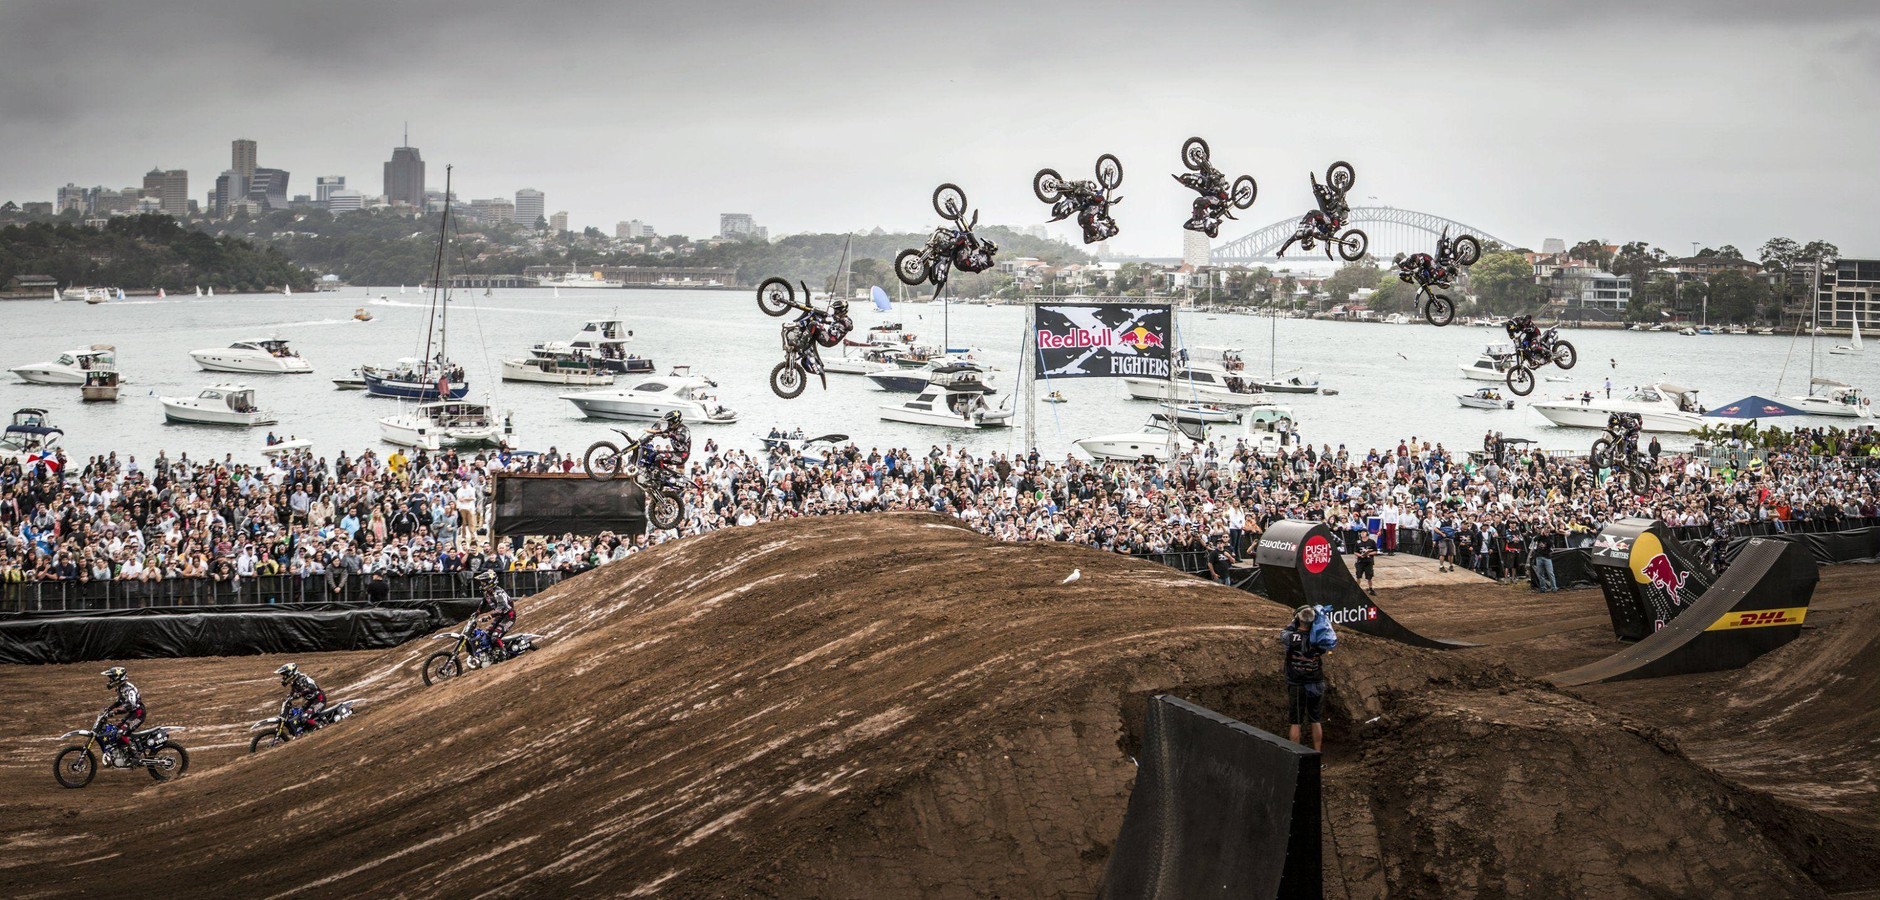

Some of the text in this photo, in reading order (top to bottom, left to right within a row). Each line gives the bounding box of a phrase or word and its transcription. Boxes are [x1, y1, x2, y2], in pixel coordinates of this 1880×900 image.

[1038, 327, 1112, 349] Red Bull
[1110, 356, 1170, 377] FIGHTERS
[1259, 539, 1291, 551] swatch
[1305, 543, 1328, 554] PUSH
[1305, 555, 1328, 564] OF FUN
[1739, 611, 1787, 626] DHL
